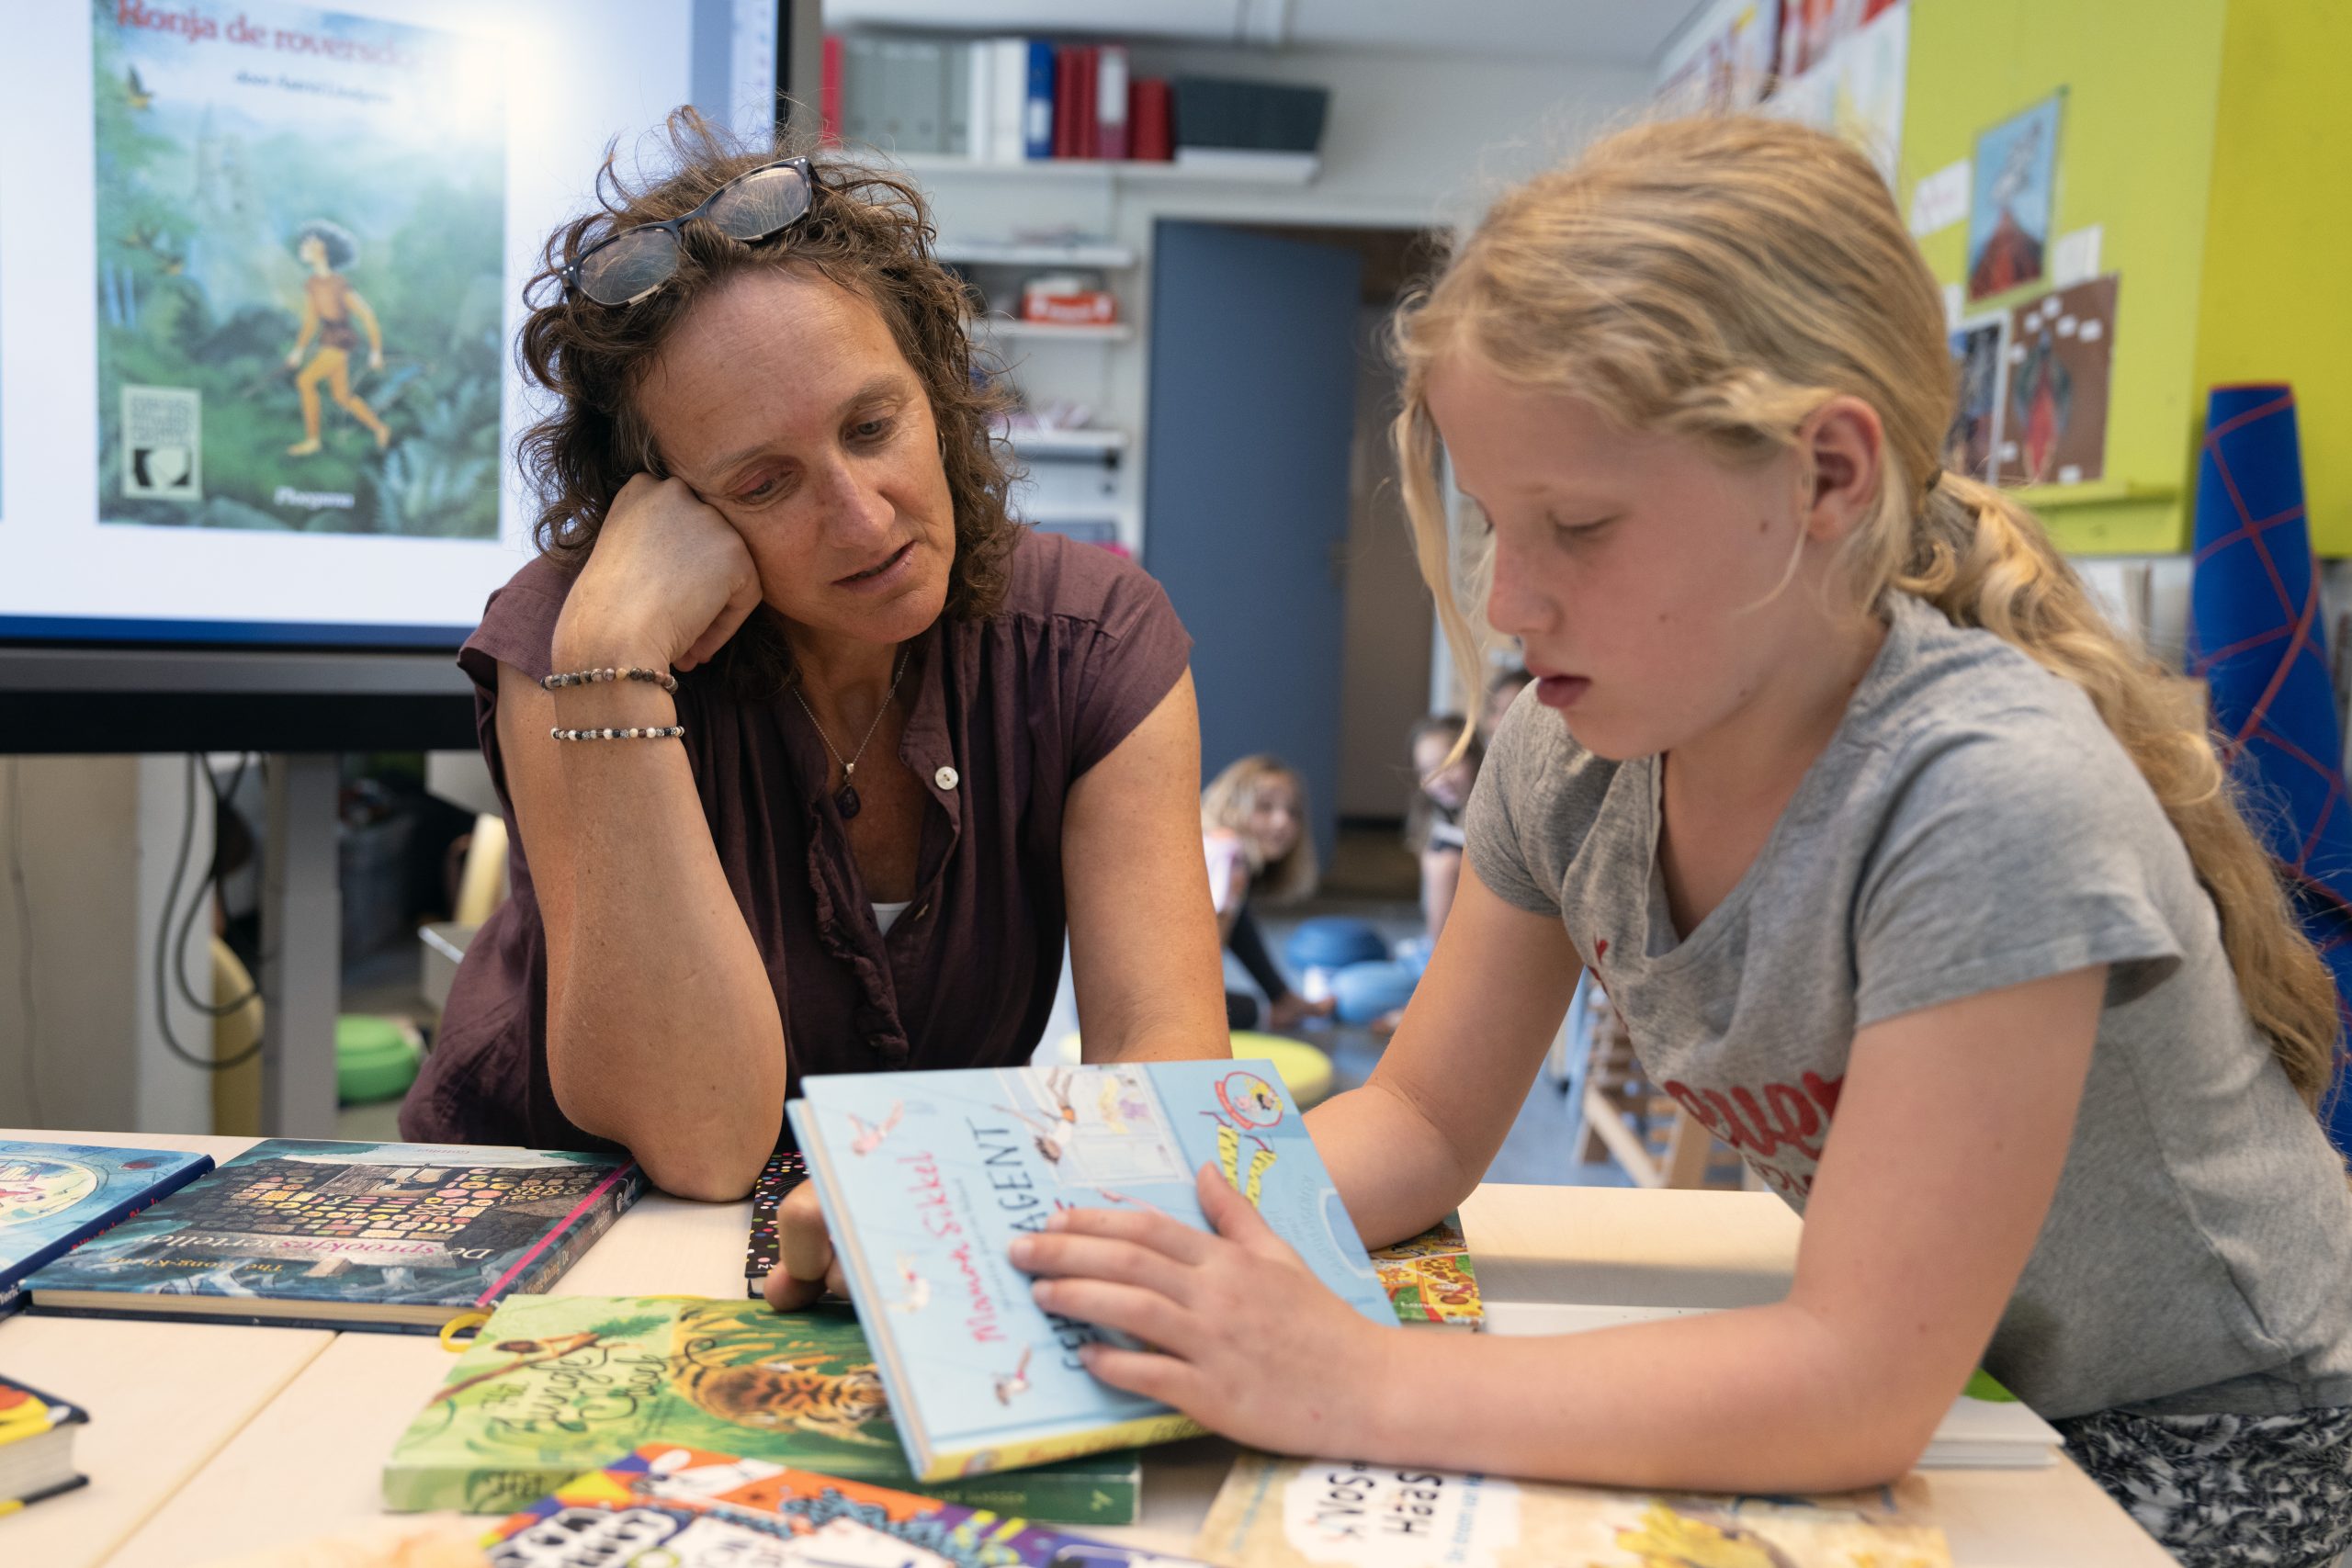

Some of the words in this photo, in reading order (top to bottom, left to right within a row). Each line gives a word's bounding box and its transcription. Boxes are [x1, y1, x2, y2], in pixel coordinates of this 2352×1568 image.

[226, 14, 267, 46] de
[966, 1116, 1048, 1233] AGENT
[448, 1247, 495, 1259] De
